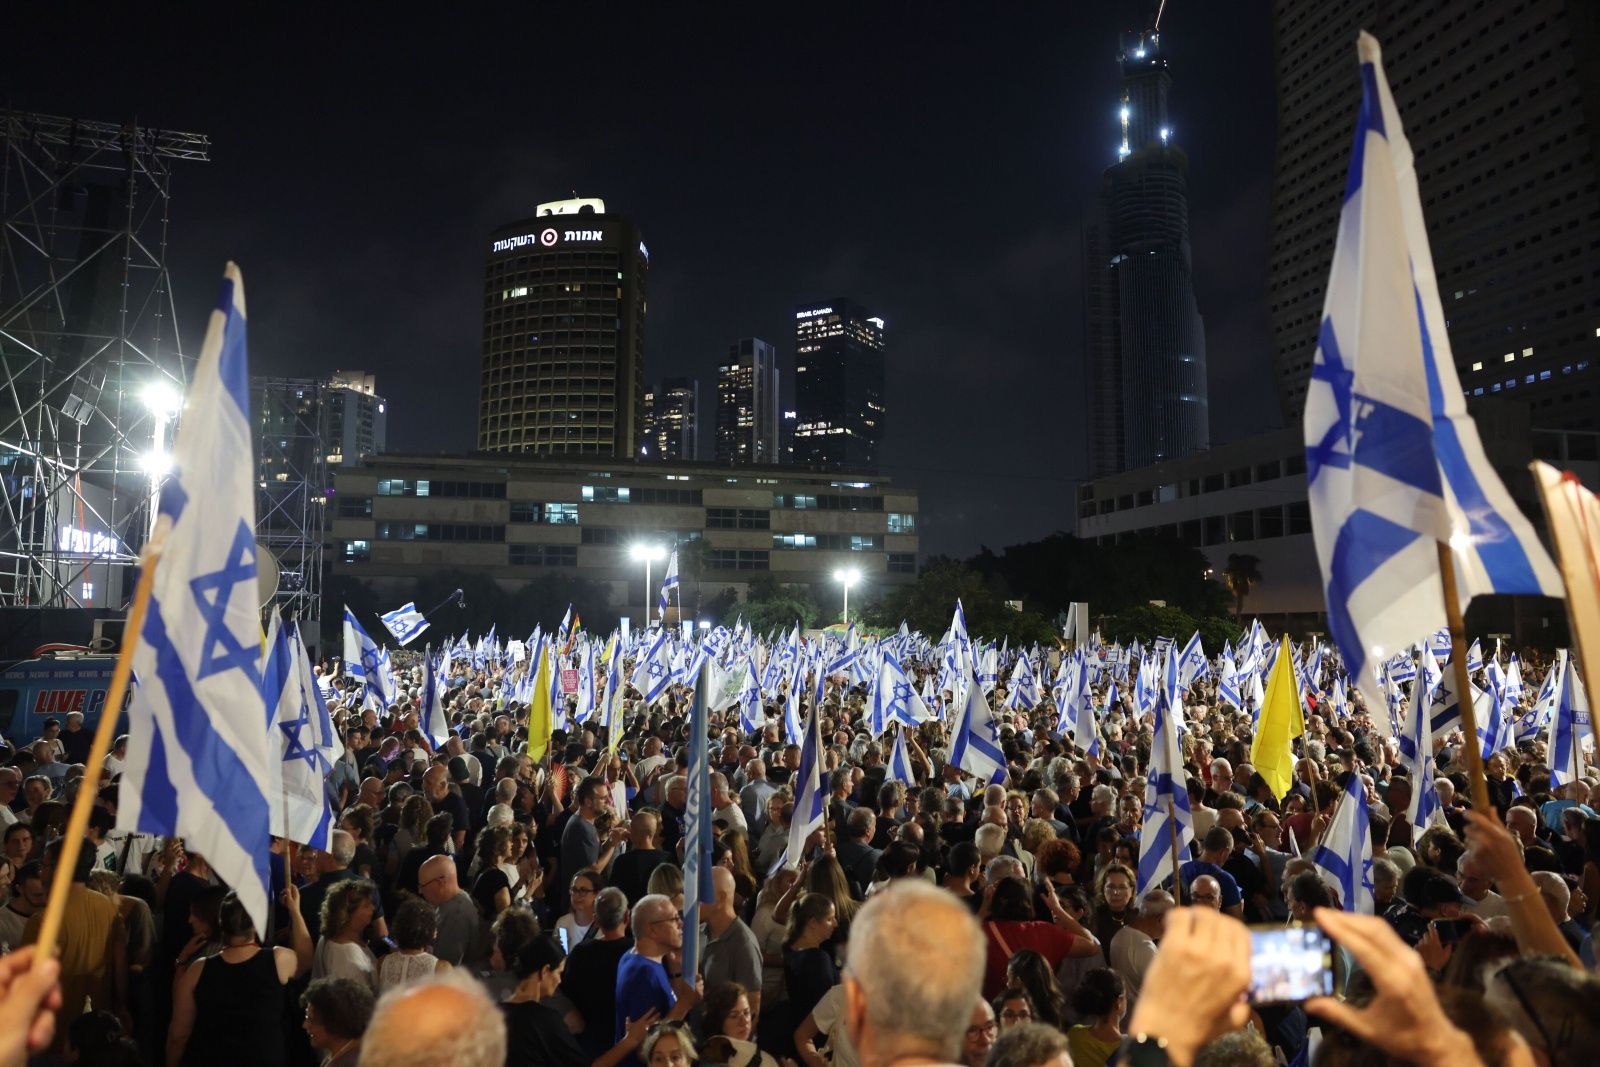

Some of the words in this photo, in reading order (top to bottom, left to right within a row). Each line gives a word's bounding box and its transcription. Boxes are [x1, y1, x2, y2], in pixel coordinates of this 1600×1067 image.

[564, 230, 602, 241] אמות
[493, 234, 535, 252] השקעות
[29, 671, 50, 679] NEWS
[53, 670, 74, 678] NEWS
[78, 670, 98, 678] NEWS
[34, 689, 87, 714] LIVE
